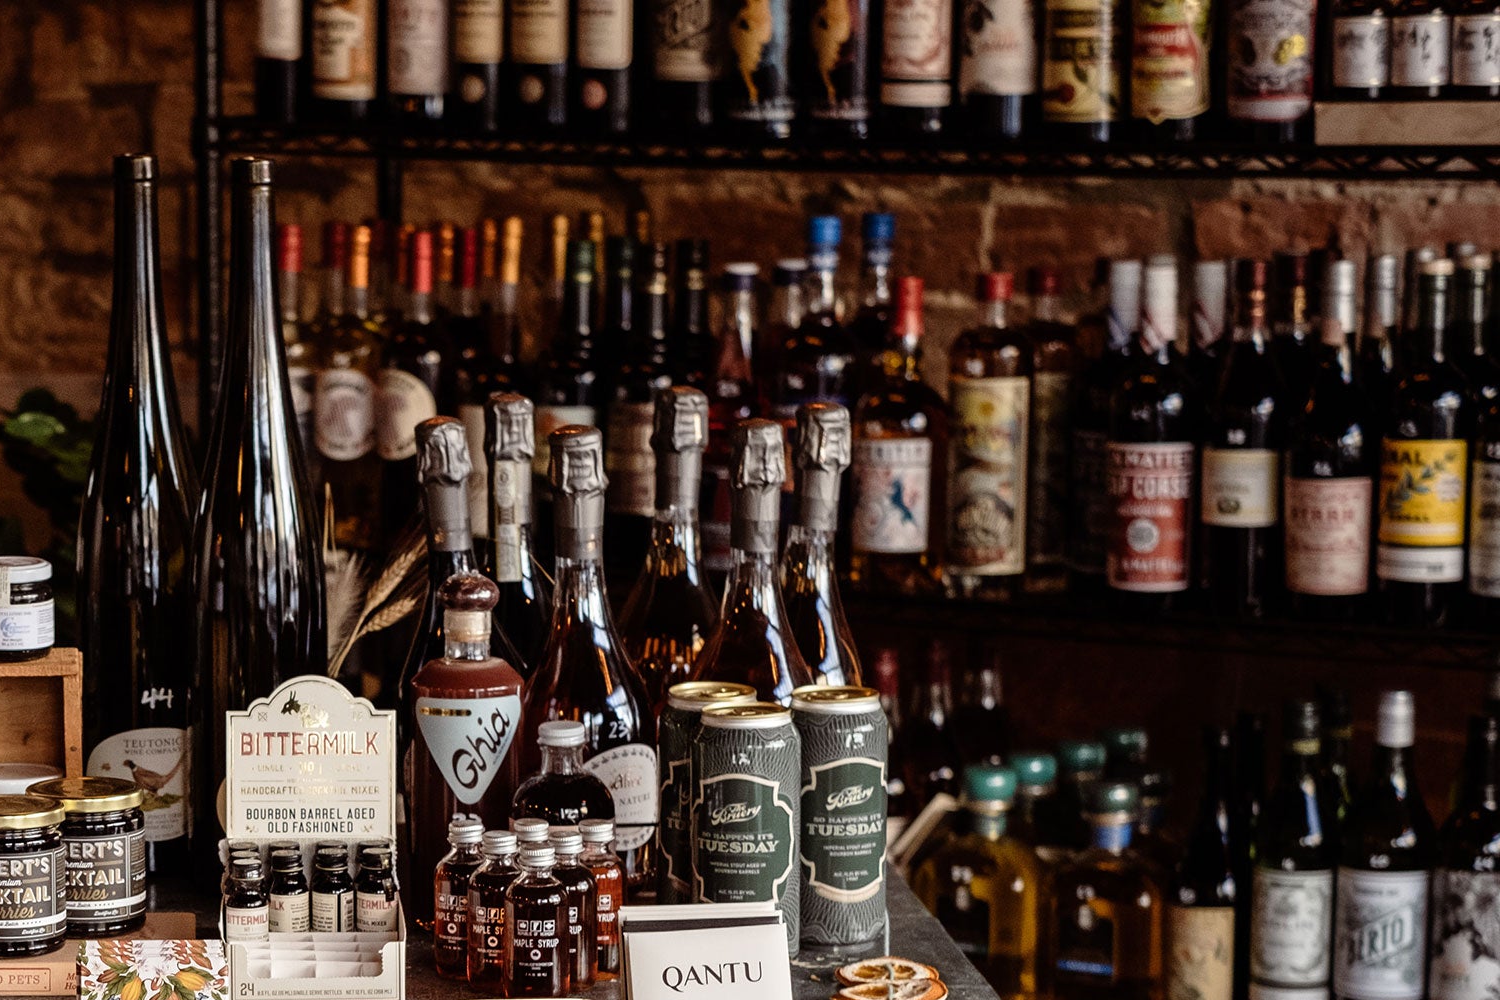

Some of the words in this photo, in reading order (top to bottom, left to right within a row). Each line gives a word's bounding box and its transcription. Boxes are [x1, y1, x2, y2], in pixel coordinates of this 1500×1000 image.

[240, 731, 379, 756] BITTERMILK
[452, 706, 510, 789] Ghia
[246, 808, 296, 820] BOURBON
[300, 808, 342, 820] BARREL
[347, 807, 375, 819] AGED
[267, 821, 288, 833] OLD
[292, 821, 354, 833] FASHIONED
[806, 819, 884, 837] TUESDAY
[700, 838, 780, 854] TUESDAY
[67, 860, 93, 869] remium
[66, 868, 125, 887] CKTAIL
[472, 924, 492, 935] MAPLE
[513, 939, 534, 948] MAPLE
[537, 938, 560, 948] SYRUP
[9, 974, 41, 985] PETS
[662, 961, 762, 992] QANTU
[240, 983, 255, 996] 24
